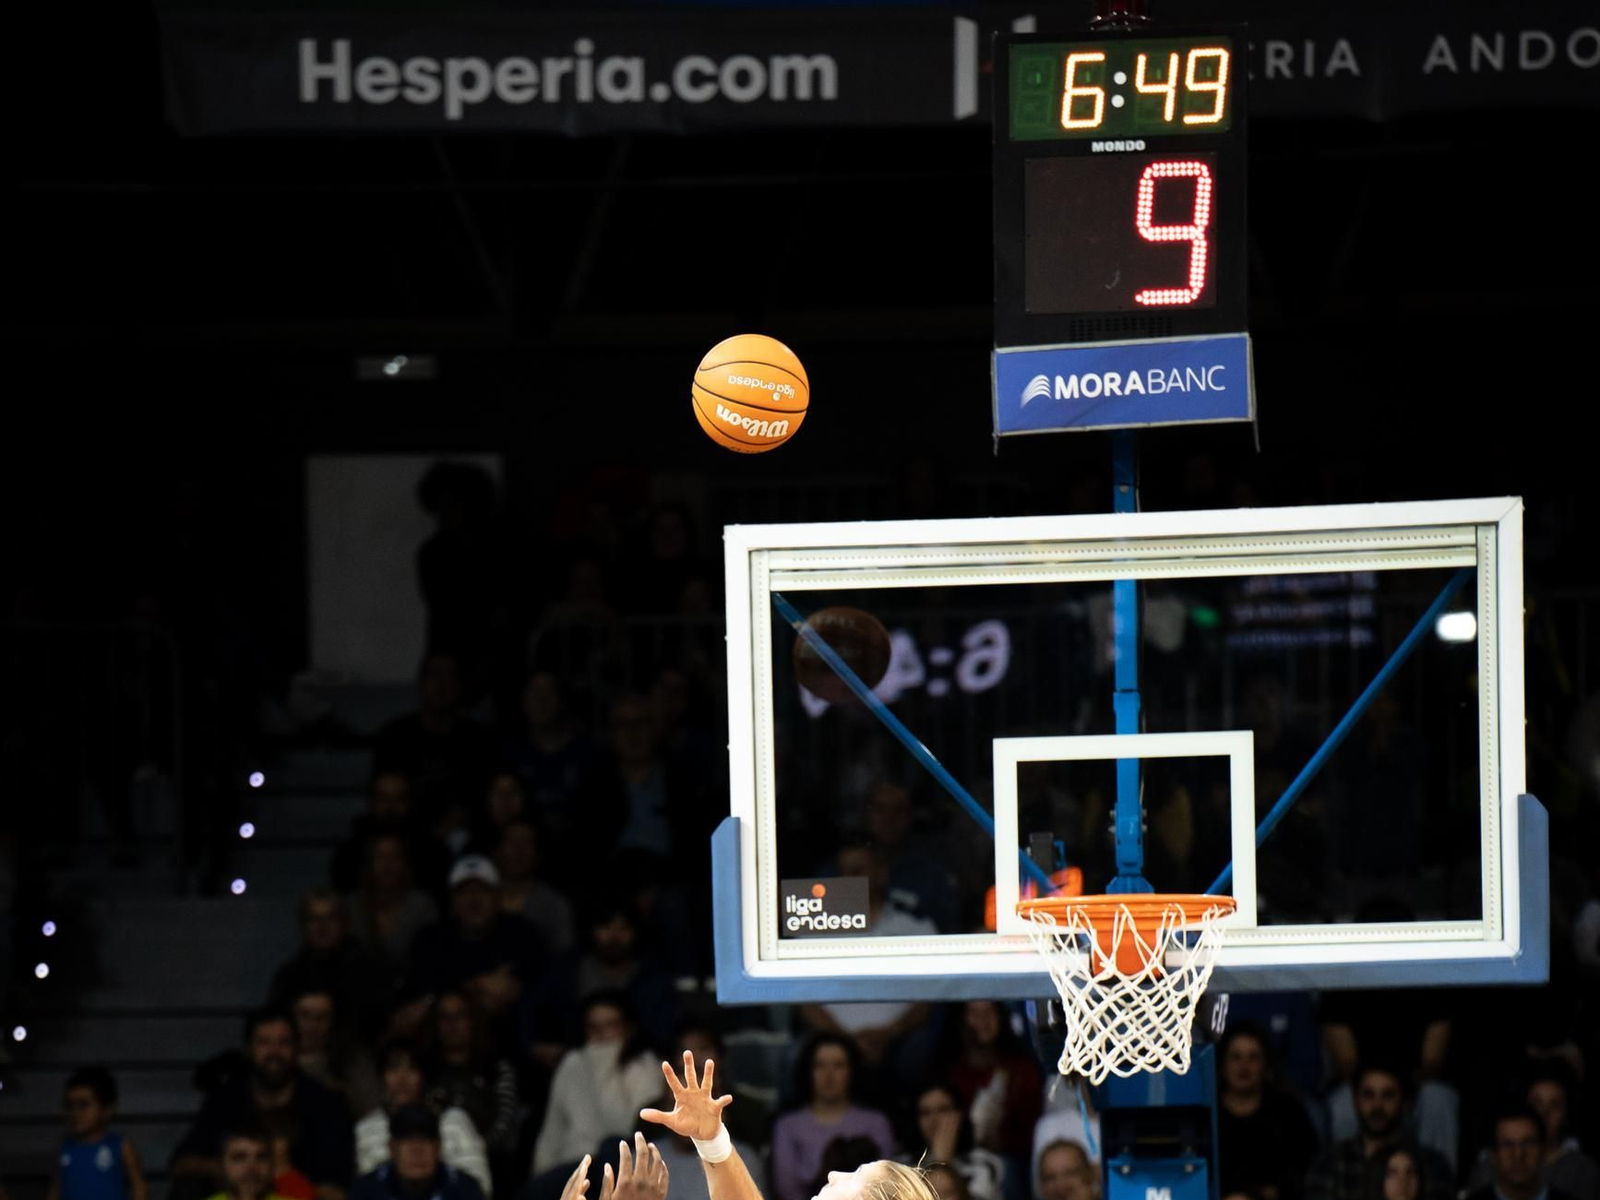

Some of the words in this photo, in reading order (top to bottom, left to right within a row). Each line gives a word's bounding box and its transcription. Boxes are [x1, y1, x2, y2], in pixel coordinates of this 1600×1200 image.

[1248, 39, 1363, 79] RIA
[1421, 28, 1600, 74] ANDO
[299, 38, 839, 120] Hesperia.com
[1061, 47, 1229, 129] 6:49
[1091, 140, 1146, 153] MONDO
[1135, 161, 1212, 305] 9
[727, 375, 776, 391] endesa
[776, 382, 796, 399] liga
[1055, 365, 1226, 400] MORABANC
[715, 403, 790, 438] Wilson
[785, 894, 823, 916] liga
[786, 911, 866, 931] endesa
